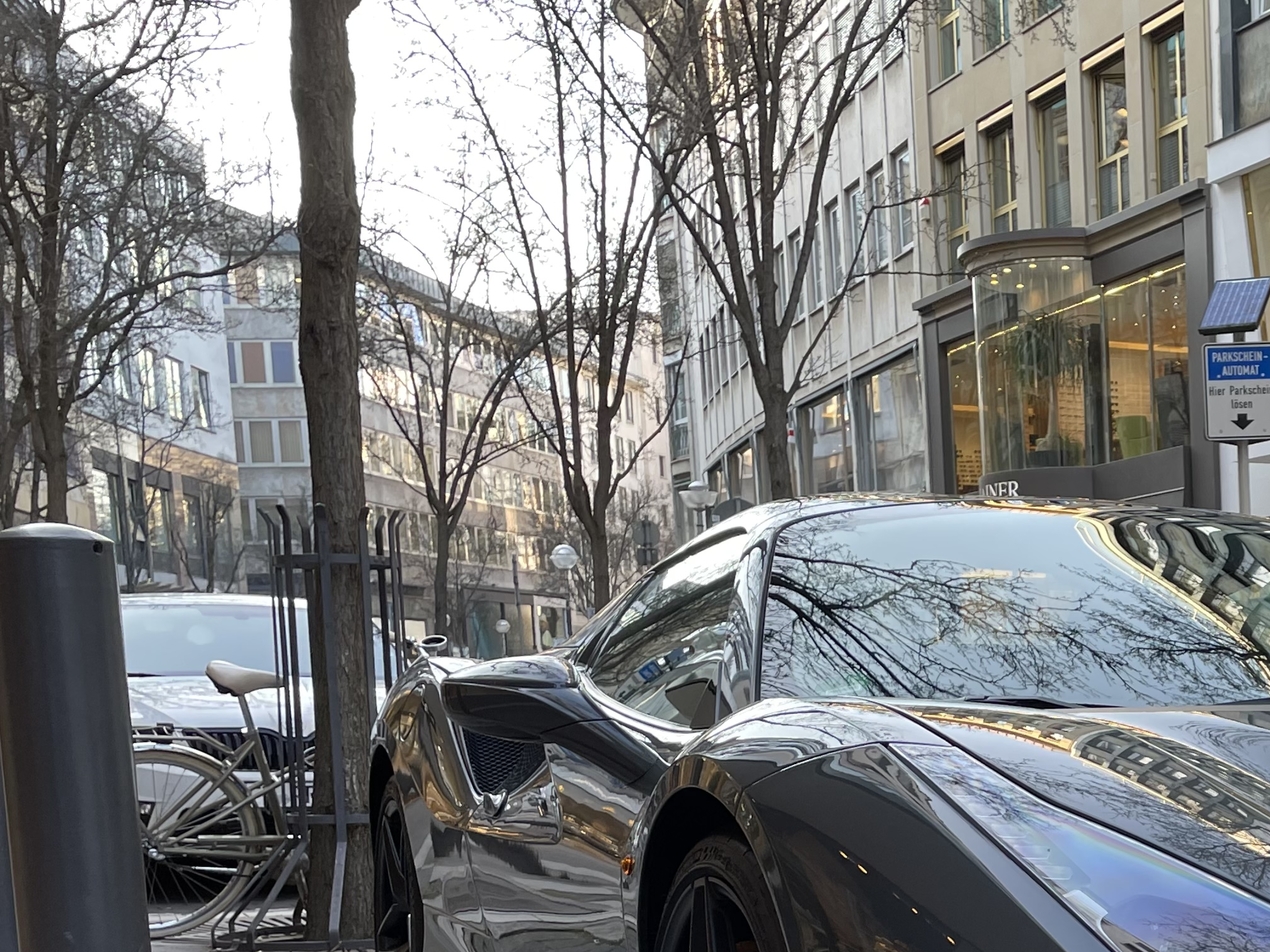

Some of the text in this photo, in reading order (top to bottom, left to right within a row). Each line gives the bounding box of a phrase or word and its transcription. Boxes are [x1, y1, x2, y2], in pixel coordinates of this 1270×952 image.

[1211, 350, 1269, 363] PARKSCHEIN-
[1222, 364, 1260, 376] AUTOMAT
[1209, 386, 1226, 396] Hier
[1231, 399, 1253, 409] lösen
